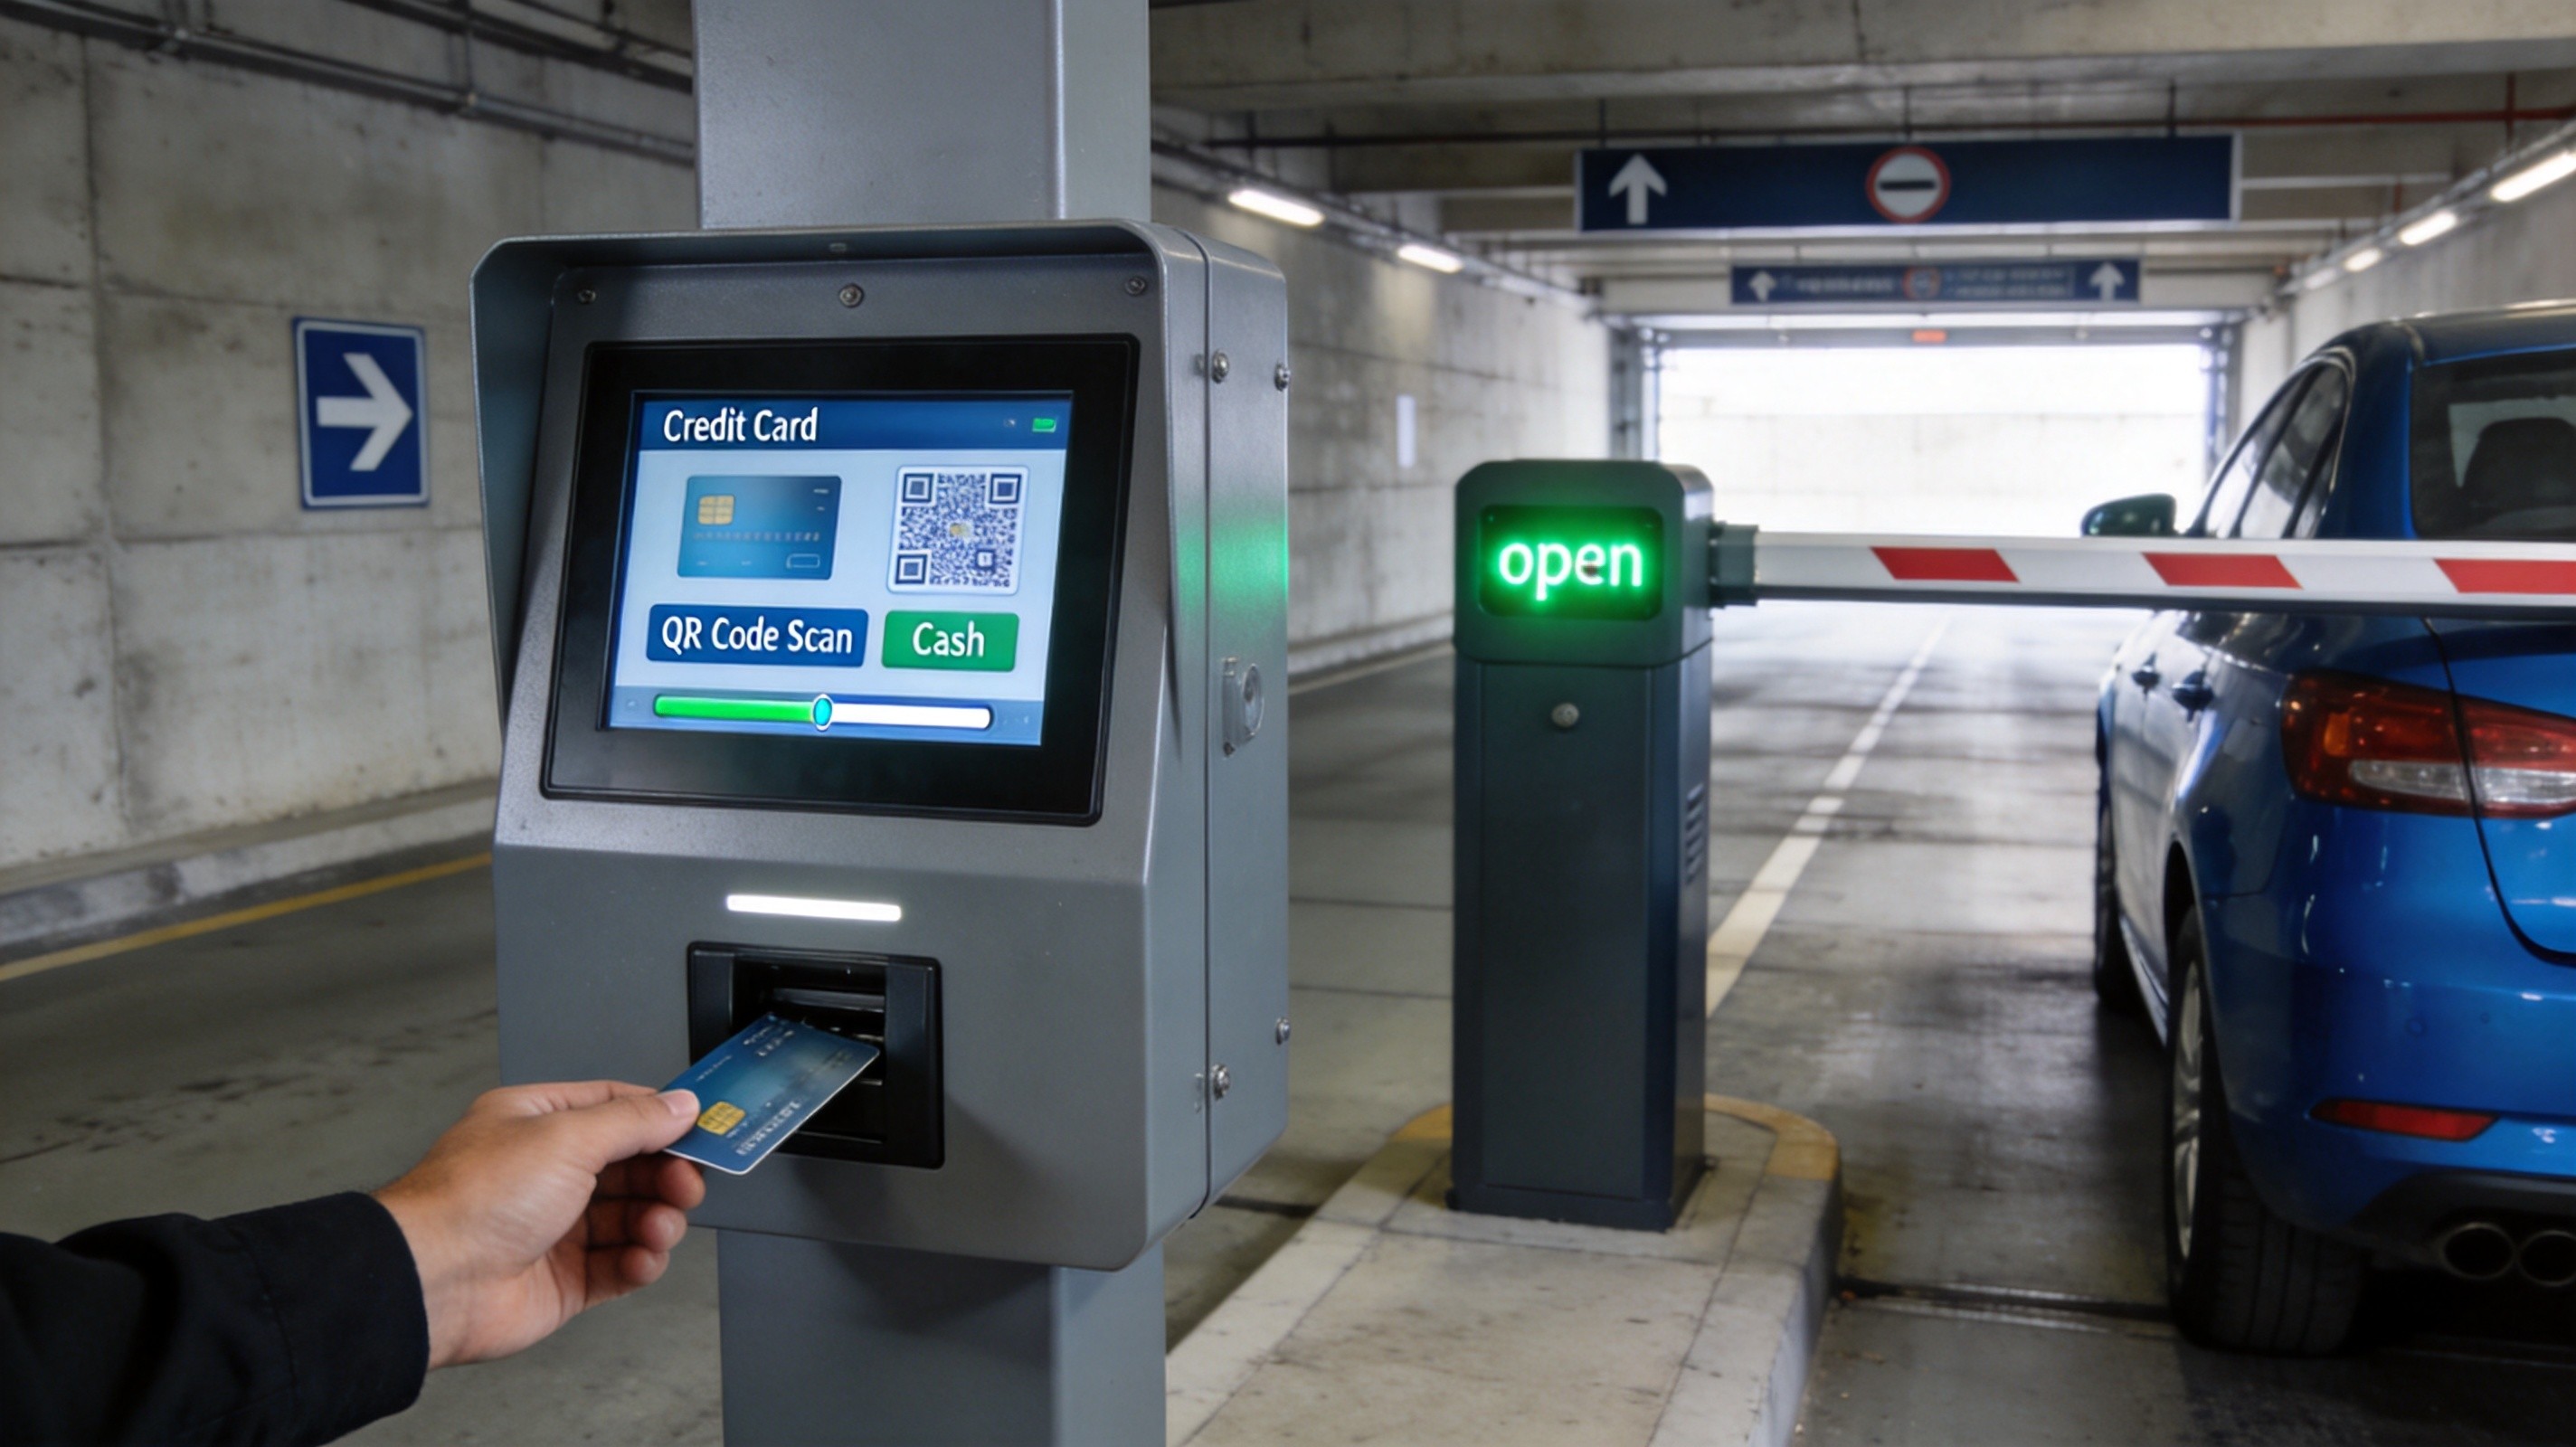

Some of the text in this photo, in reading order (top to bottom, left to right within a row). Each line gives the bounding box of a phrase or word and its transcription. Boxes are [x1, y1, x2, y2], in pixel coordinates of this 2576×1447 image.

[663, 407, 818, 442] Credit Card
[1498, 543, 1643, 601] open
[661, 616, 853, 656] QR Code Scan
[912, 620, 985, 657] Cash
